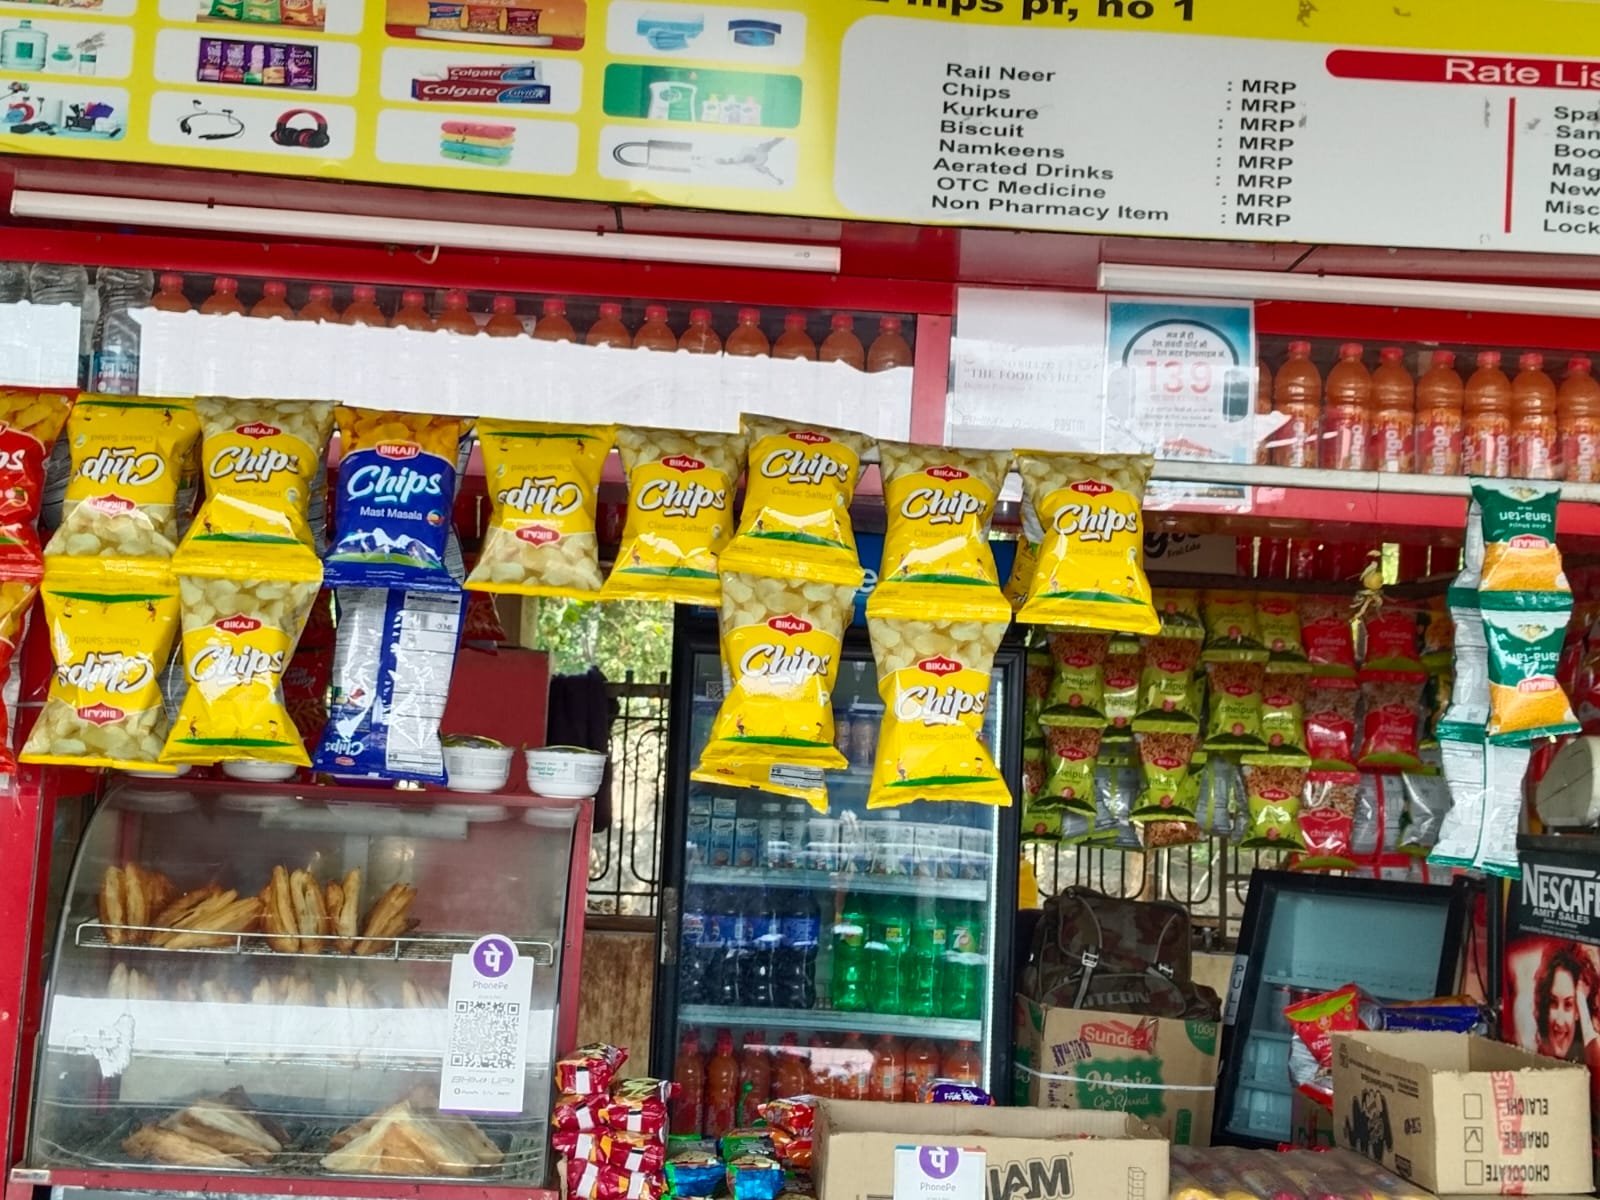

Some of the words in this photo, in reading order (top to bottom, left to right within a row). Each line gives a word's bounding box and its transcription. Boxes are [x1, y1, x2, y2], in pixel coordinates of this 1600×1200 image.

[1097, 0, 1154, 19] no
[1174, 0, 1193, 21] 1
[450, 68, 500, 77] Colgate
[947, 63, 990, 80] Rail
[999, 66, 1056, 82] Neer
[1241, 79, 1296, 95] MRP
[1445, 58, 1541, 84] Rate
[422, 84, 498, 97] Colgate
[942, 82, 1011, 100] Chips
[1241, 98, 1296, 114] MRP
[943, 101, 1039, 120] Kurkure
[1240, 117, 1295, 133] MRP
[940, 120, 1024, 138] Biscuit
[1239, 136, 1294, 152] MRP
[939, 139, 1065, 159] Namkeens
[1238, 155, 1293, 171] MRP
[933, 158, 1027, 176] Aerated
[1036, 163, 1114, 181] Drinks
[1237, 174, 1293, 190] MRP
[1552, 162, 1600, 181] Mag
[937, 177, 989, 193] OTC
[998, 180, 1106, 200] Medicine
[1236, 193, 1292, 209] MRP
[1550, 182, 1600, 197] New
[931, 195, 979, 211] Non
[988, 199, 1109, 221] Pharmacy
[1118, 205, 1169, 222] Item
[1235, 211, 1291, 227] MRP
[1545, 201, 1600, 216] Misc
[1543, 219, 1600, 235] Lock
[1146, 360, 1213, 393] 139
[243, 426, 274, 435] BIKAJI
[795, 433, 825, 443] BIKAJI
[381, 445, 416, 456] BIKAJI
[669, 458, 699, 469] BIKAJI
[932, 468, 963, 479] BIKAJI
[347, 465, 442, 503] Chips
[1078, 483, 1107, 493] BIKAJI
[636, 479, 726, 517] Chips
[360, 506, 385, 518] Mast
[387, 508, 423, 521] Masala
[1052, 503, 1138, 542] Chips
[1499, 511, 1552, 523] tana-tan
[223, 619, 255, 631] BIKAJI
[775, 618, 805, 632] BIKAJI
[190, 645, 286, 687] Chips
[739, 643, 831, 685] Chips
[925, 660, 956, 672] BIKAJI
[84, 708, 117, 719] BIKAJI
[894, 685, 986, 726] Chips
[325, 738, 364, 756] Chips
[1532, 907, 1556, 919] AMIT
[1558, 911, 1591, 925] SALES
[483, 943, 504, 972] पे
[472, 980, 509, 991] PhonePe
[1504, 1097, 1549, 1116] ELAICHI
[1504, 1131, 1550, 1149] ORANGE
[1485, 1163, 1550, 1182] CHOCOLATE
[920, 1182, 957, 1192] PhonePe
